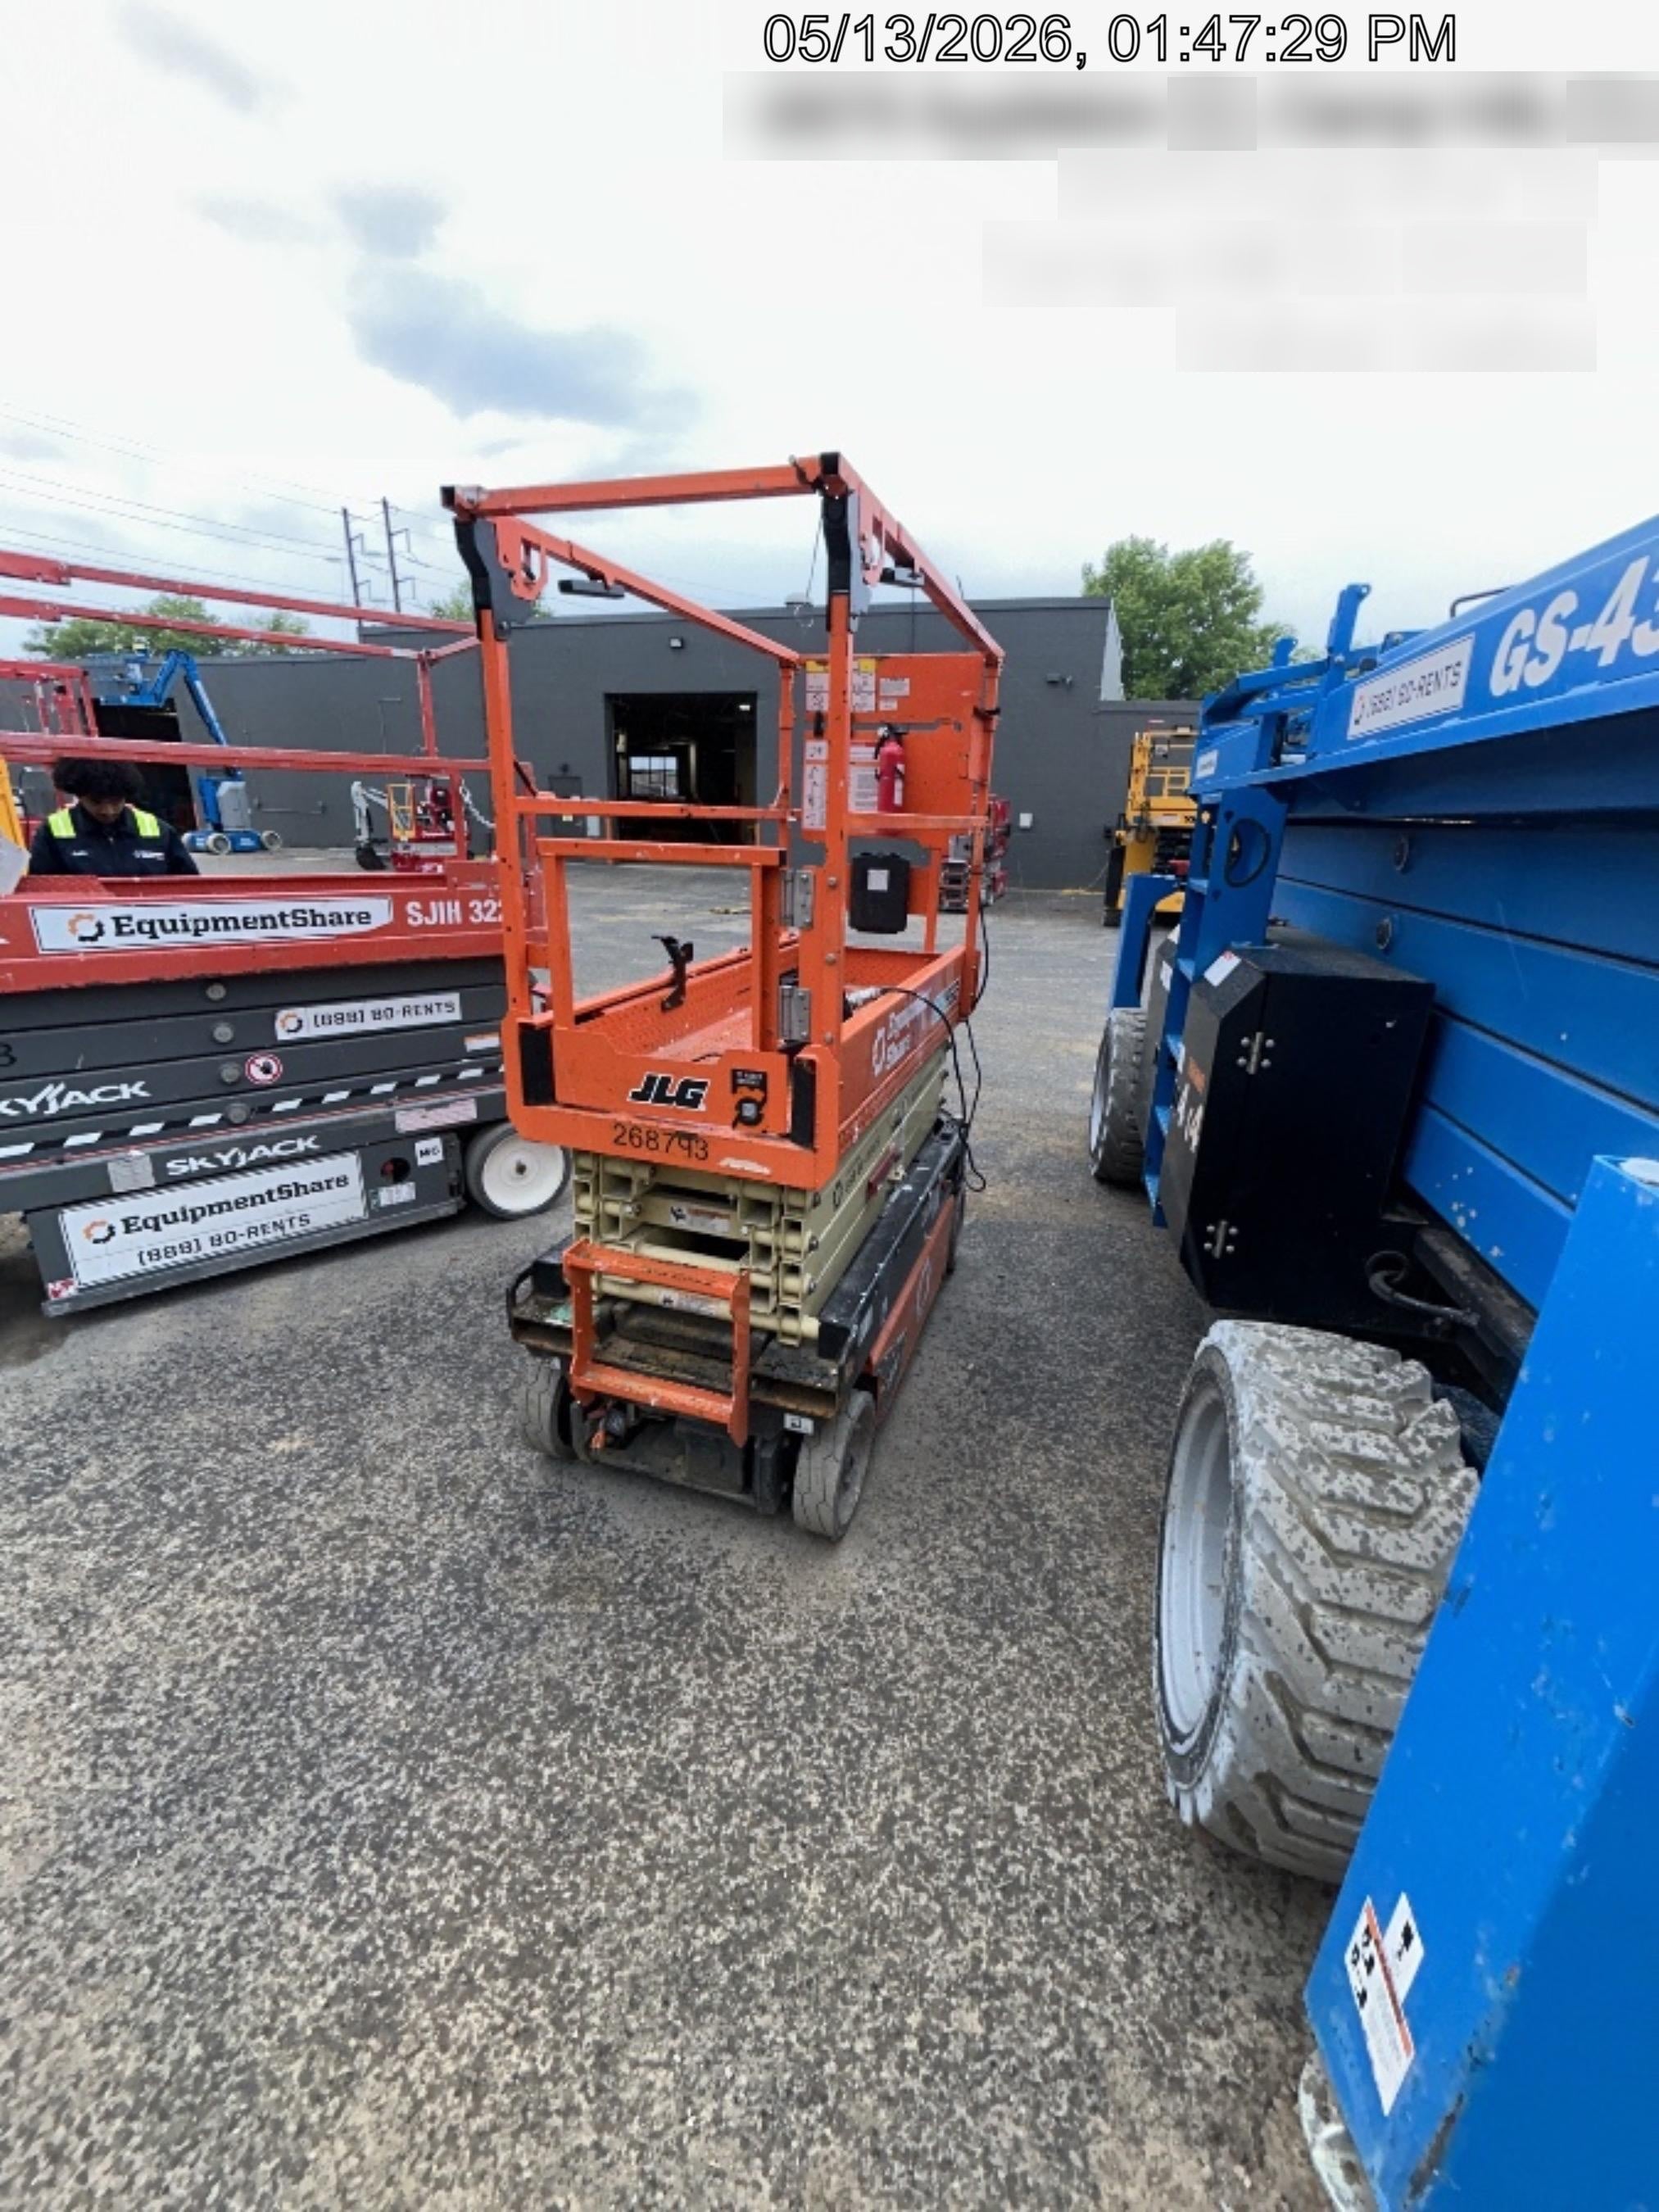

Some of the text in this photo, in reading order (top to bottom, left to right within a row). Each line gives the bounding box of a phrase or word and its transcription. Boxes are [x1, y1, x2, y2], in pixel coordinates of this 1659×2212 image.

[111, 908, 372, 939] EquipmentShare
[628, 1072, 710, 1112] JLG
[165, 1135, 321, 1176] SKYJACK
[120, 1174, 350, 1234] EquipmentShare
